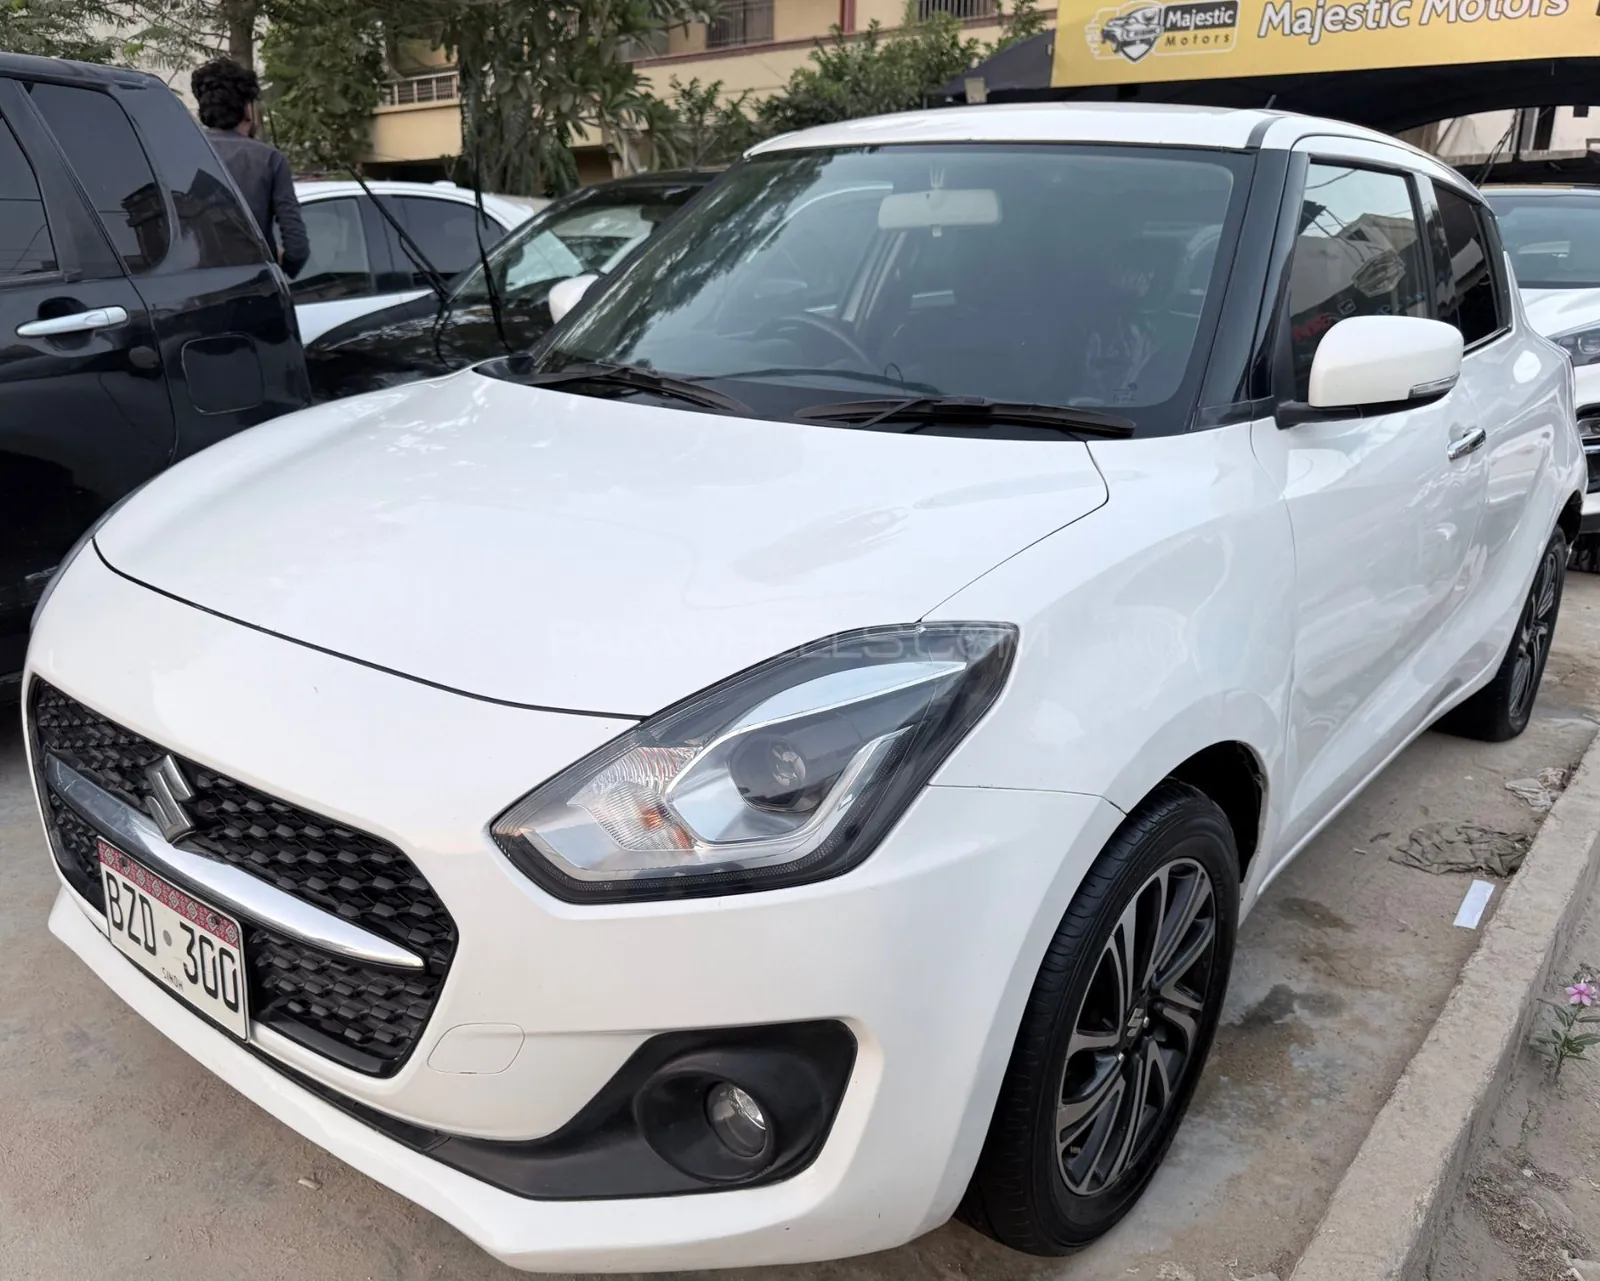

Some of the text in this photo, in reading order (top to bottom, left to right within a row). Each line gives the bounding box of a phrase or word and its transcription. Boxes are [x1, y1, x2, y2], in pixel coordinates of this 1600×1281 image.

[1166, 8, 1235, 31] Majestic
[1257, 0, 1569, 45] Majestic Motors
[1165, 33, 1230, 47] Motors
[105, 871, 239, 1014] BZD 300
